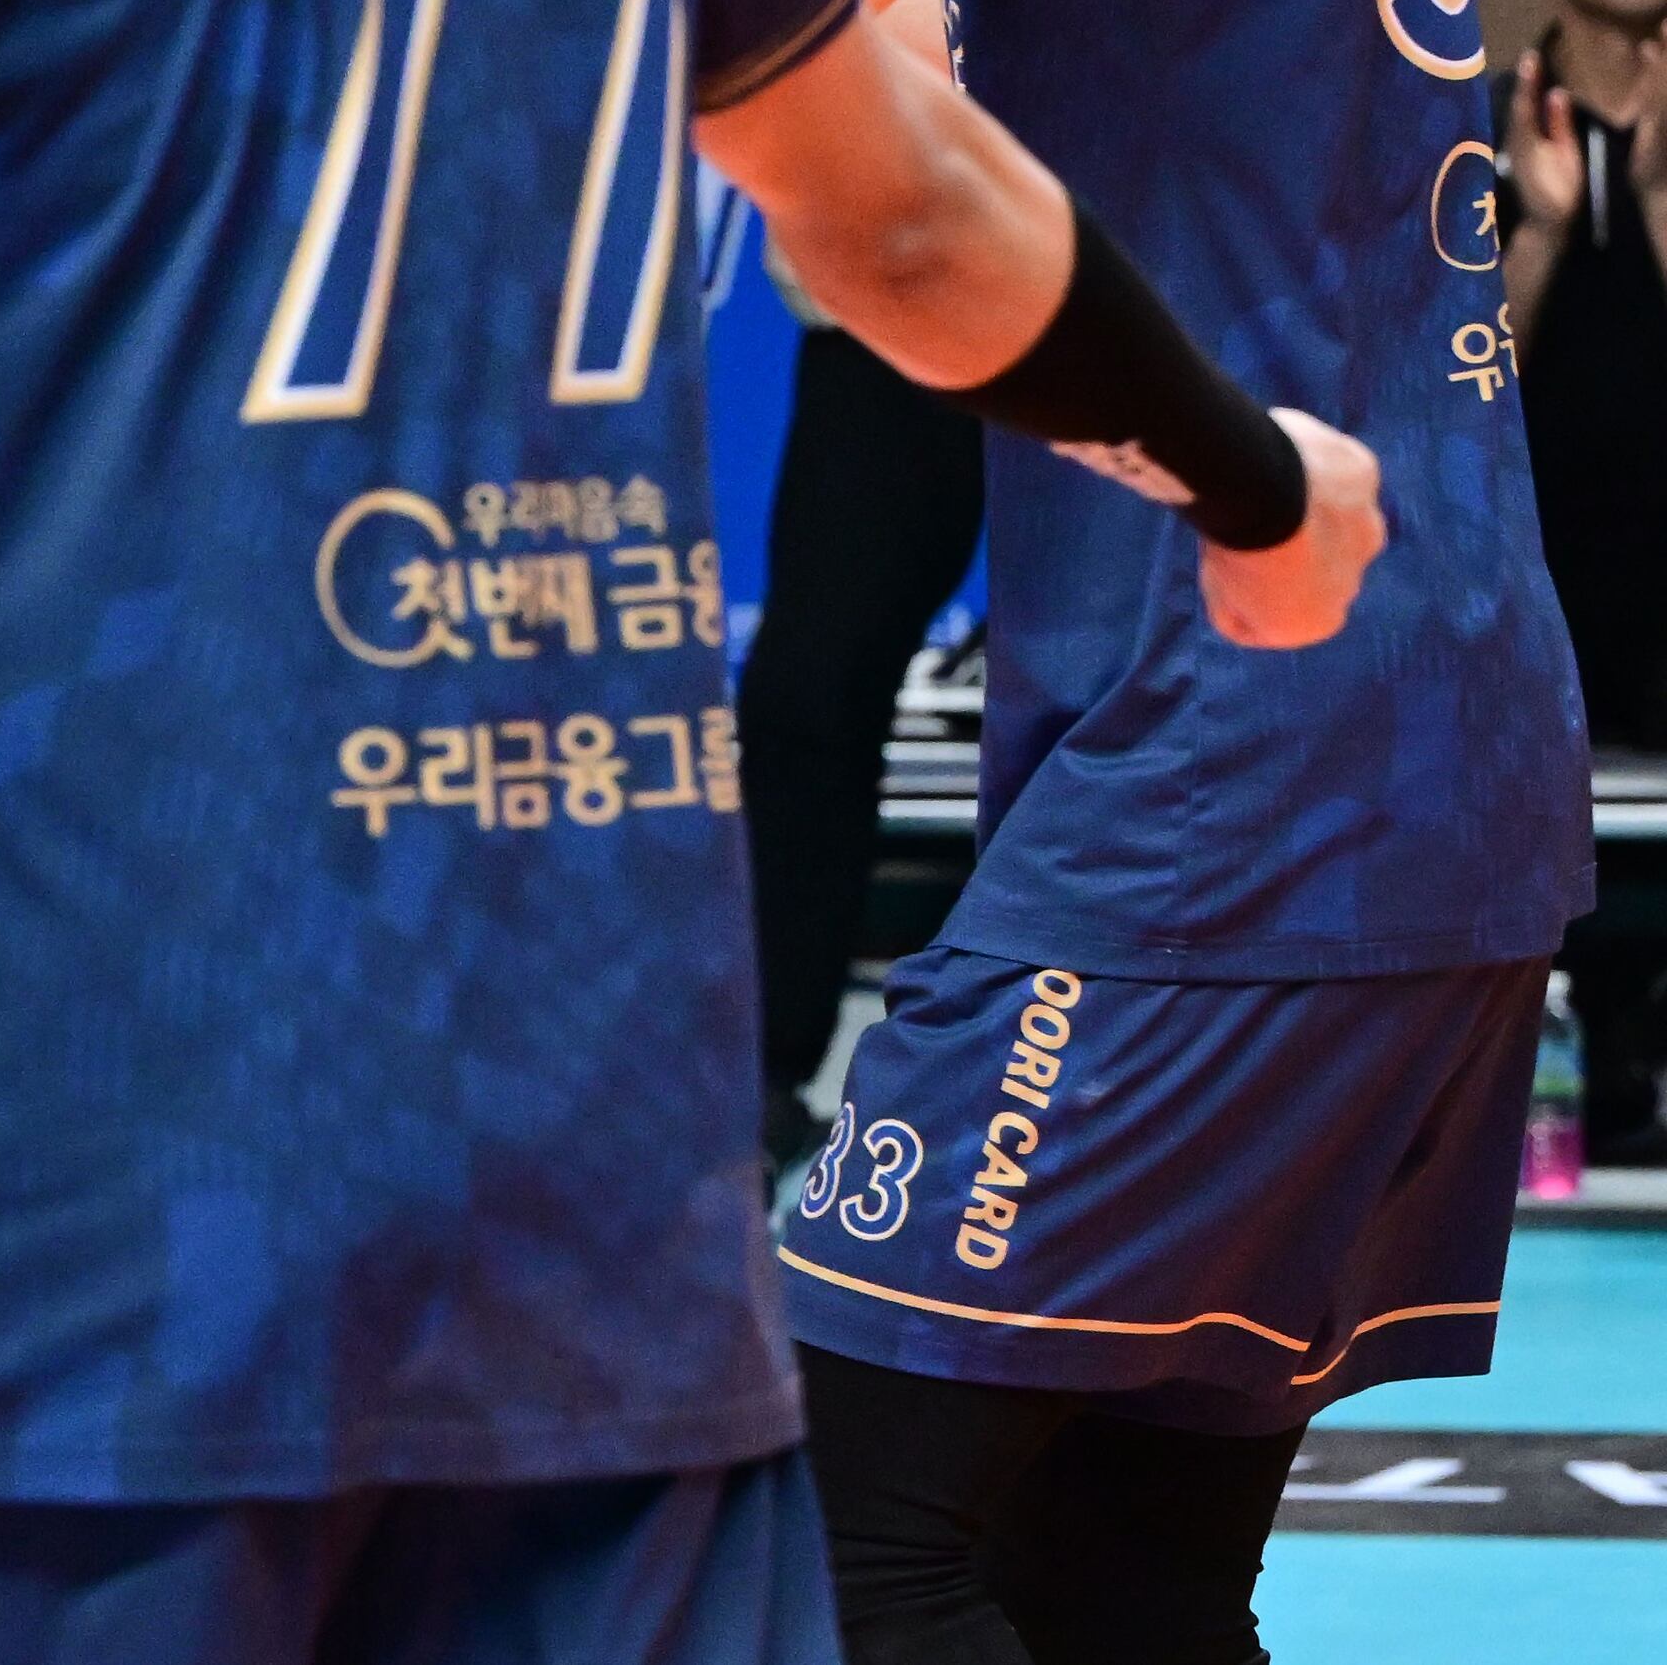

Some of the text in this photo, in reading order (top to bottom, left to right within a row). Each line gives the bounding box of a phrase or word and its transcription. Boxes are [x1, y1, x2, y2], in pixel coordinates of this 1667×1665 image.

[389, 550, 600, 660] 첫번째
[798, 1099, 925, 1242] 33
[955, 1111, 1040, 1271] CARD
